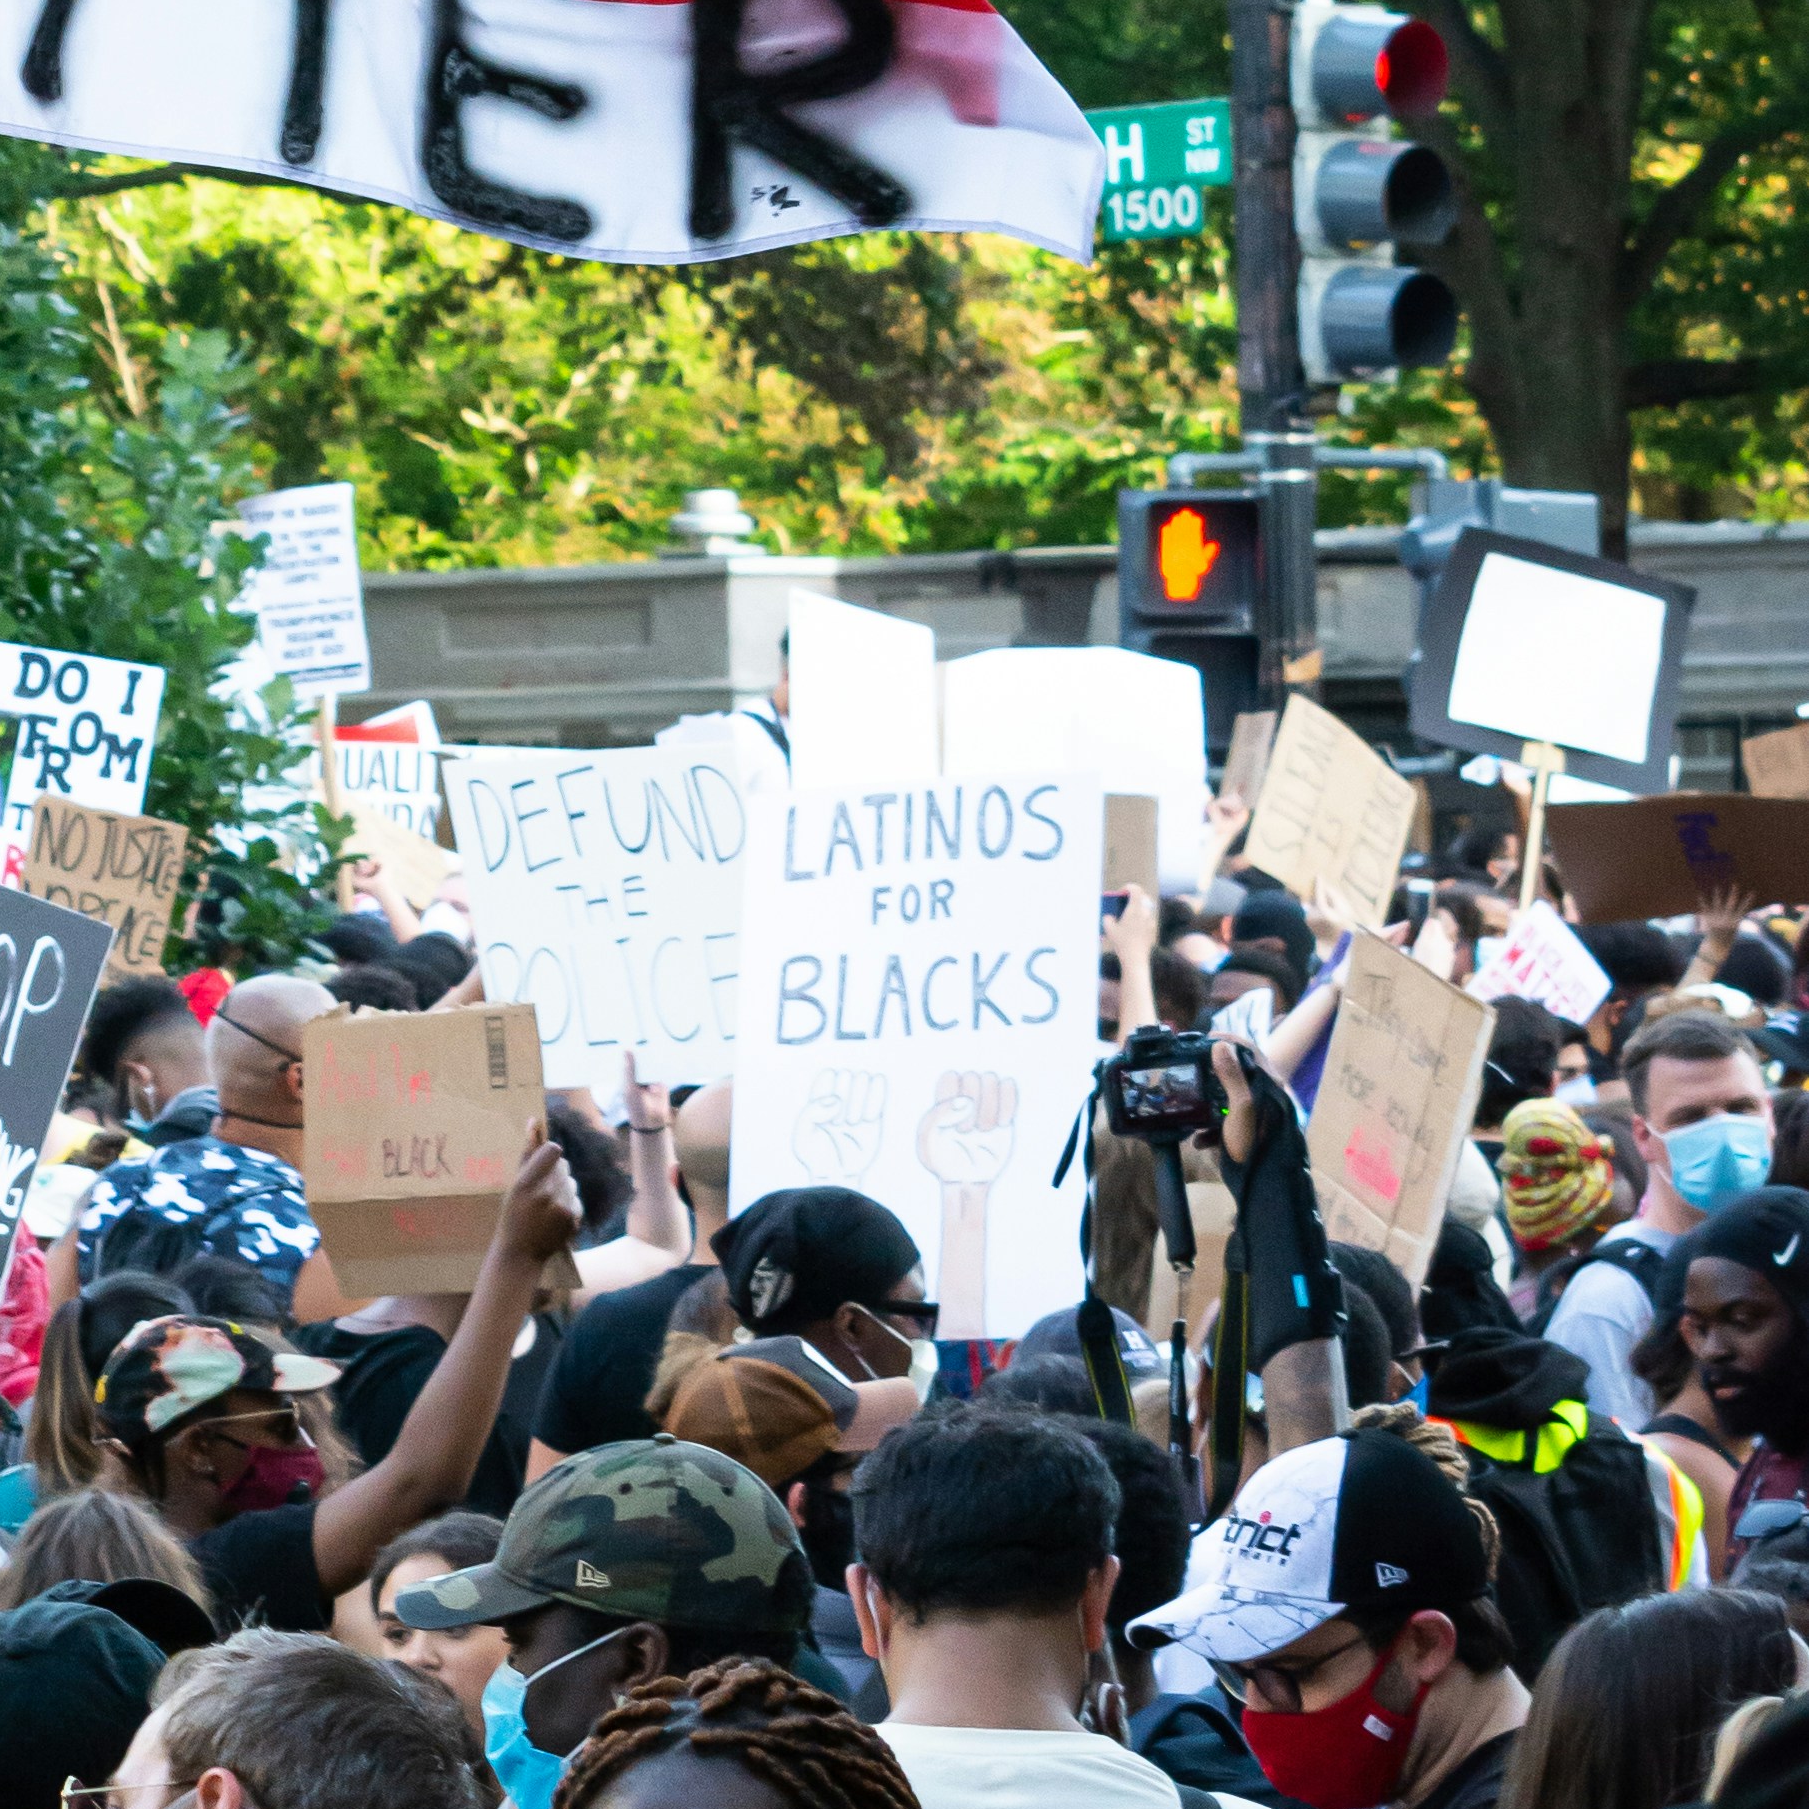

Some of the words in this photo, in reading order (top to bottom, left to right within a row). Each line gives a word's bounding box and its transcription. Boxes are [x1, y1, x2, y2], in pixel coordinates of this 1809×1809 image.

[1103, 122, 1145, 184] H
[1185, 117, 1217, 145] ST
[1185, 149, 1221, 174] NW
[1107, 185, 1199, 232] 1500
[13, 651, 89, 704] DO
[119, 669, 142, 716] I
[20, 711, 143, 793] FROM
[8, 802, 35, 831] T
[33, 806, 90, 873] NO
[467, 764, 747, 874] DEFUND
[783, 784, 1064, 882] LATINOS
[555, 875, 649, 928] THE
[871, 878, 955, 926] FOR
[485, 932, 740, 1047] POLICE
[776, 946, 1060, 1047] BLACKS
[381, 1132, 454, 1179] BLACK
